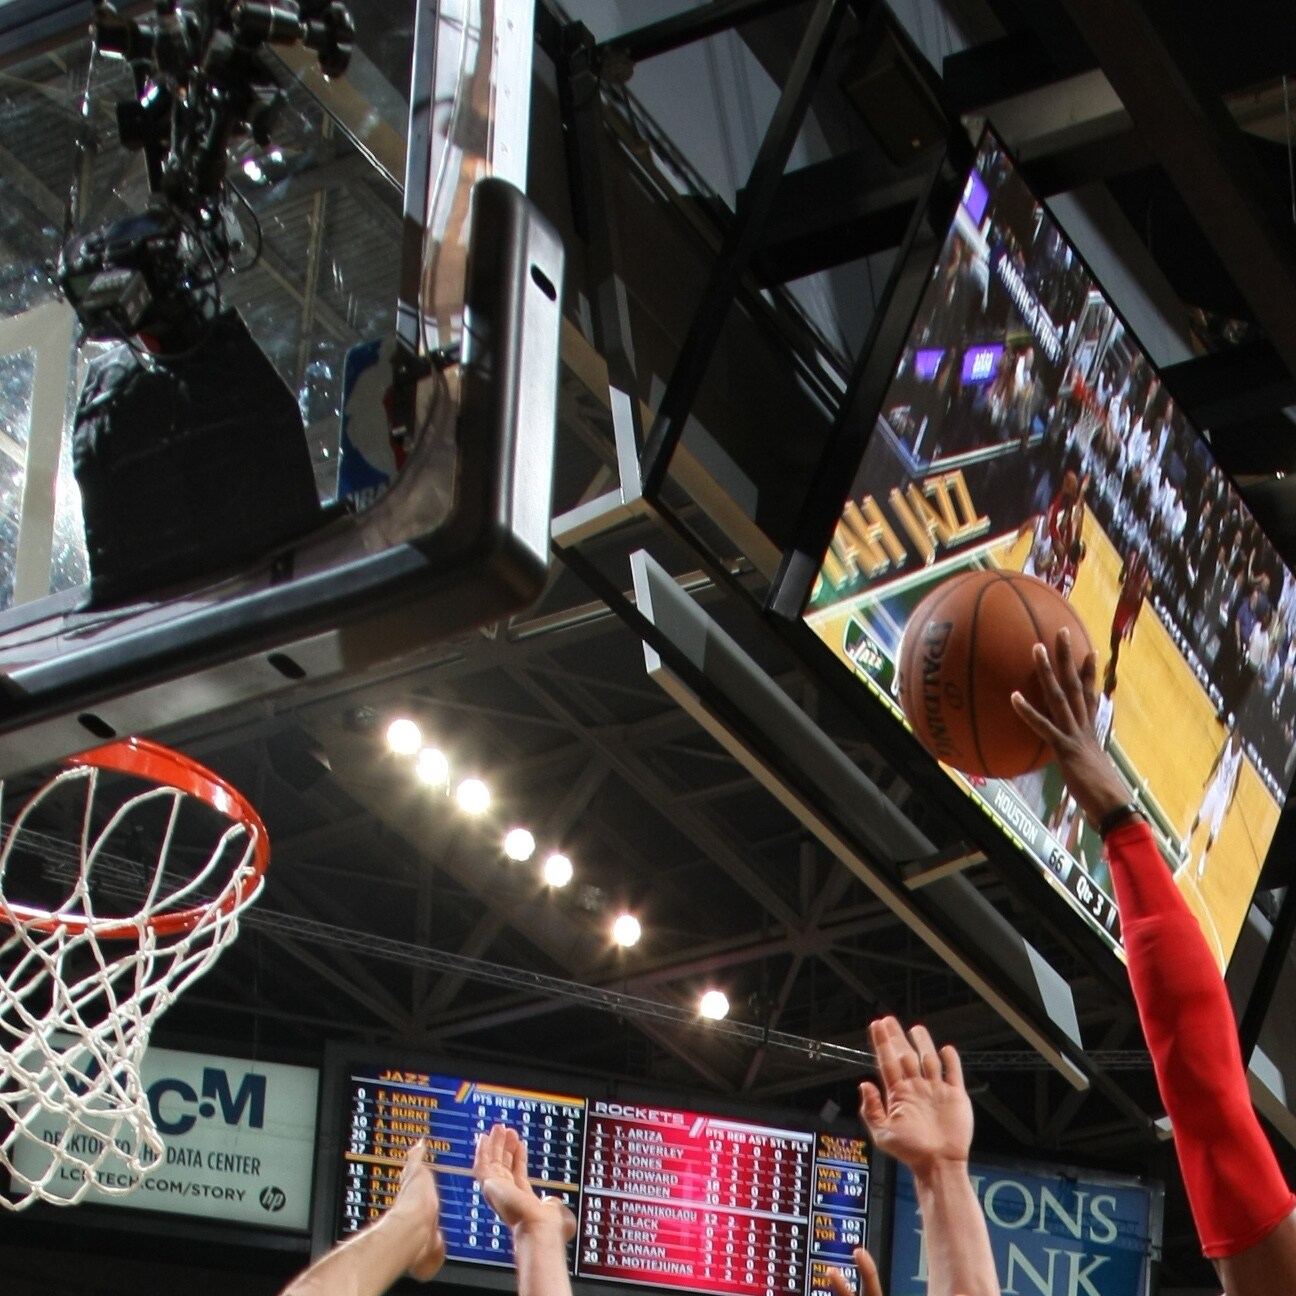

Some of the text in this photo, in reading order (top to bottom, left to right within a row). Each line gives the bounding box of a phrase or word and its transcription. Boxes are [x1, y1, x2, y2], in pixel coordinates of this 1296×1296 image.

[994, 787, 1038, 845] HOUSTON
[1049, 848, 1065, 872] 66
[1093, 894, 1104, 917] 3
[379, 1069, 430, 1086] JAZZ
[358, 1088, 438, 1108] 0 KANTER
[472, 1092, 493, 1105] PTS
[495, 1096, 516, 1109] REB
[517, 1100, 538, 1112] AST
[540, 1102, 559, 1116] STL
[595, 1101, 685, 1124] ROCKETS
[391, 1134, 450, 1152] HAYARD
[628, 1128, 663, 1143] ARIZA
[44, 1130, 105, 1155] DEKTO
[167, 1146, 202, 1168] DATA
[207, 1151, 260, 1176] CENTER
[628, 1141, 684, 1160] BEVERLEY
[627, 1155, 663, 1170] JONES
[627, 1169, 679, 1185] HOWARD
[818, 1169, 842, 1179] WAS
[624, 1181, 671, 1199] HARDEN
[818, 1181, 862, 1196] MIA 107
[622, 1201, 697, 1221] PAPANIKOLAOU
[622, 1215, 659, 1230] BLACK
[815, 1216, 833, 1227] ATL
[621, 1228, 657, 1243] TERRY
[815, 1228, 860, 1244] TOR 109
[620, 1243, 666, 1258] CANAAN
[622, 1256, 694, 1276] MOTIEJUNAS
